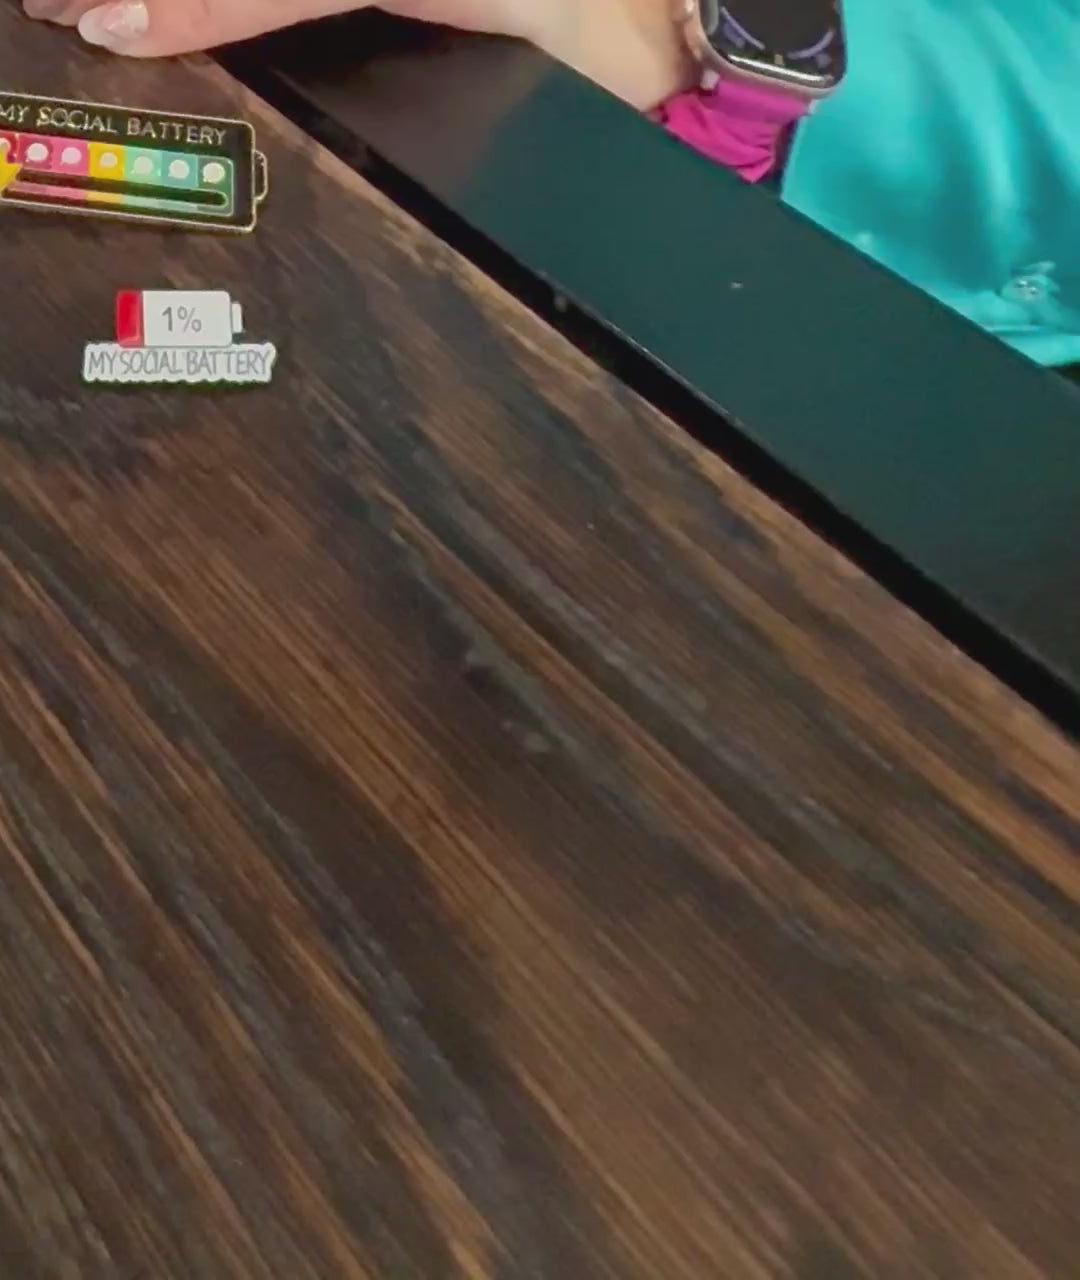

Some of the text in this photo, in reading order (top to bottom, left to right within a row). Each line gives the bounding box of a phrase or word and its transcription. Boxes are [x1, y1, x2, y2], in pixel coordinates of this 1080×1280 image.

[35, 105, 119, 134] SOCIAL
[127, 116, 227, 146] BATTERY
[161, 305, 202, 333] 1%
[88, 350, 270, 376] MY SOCIAL BATTERY
